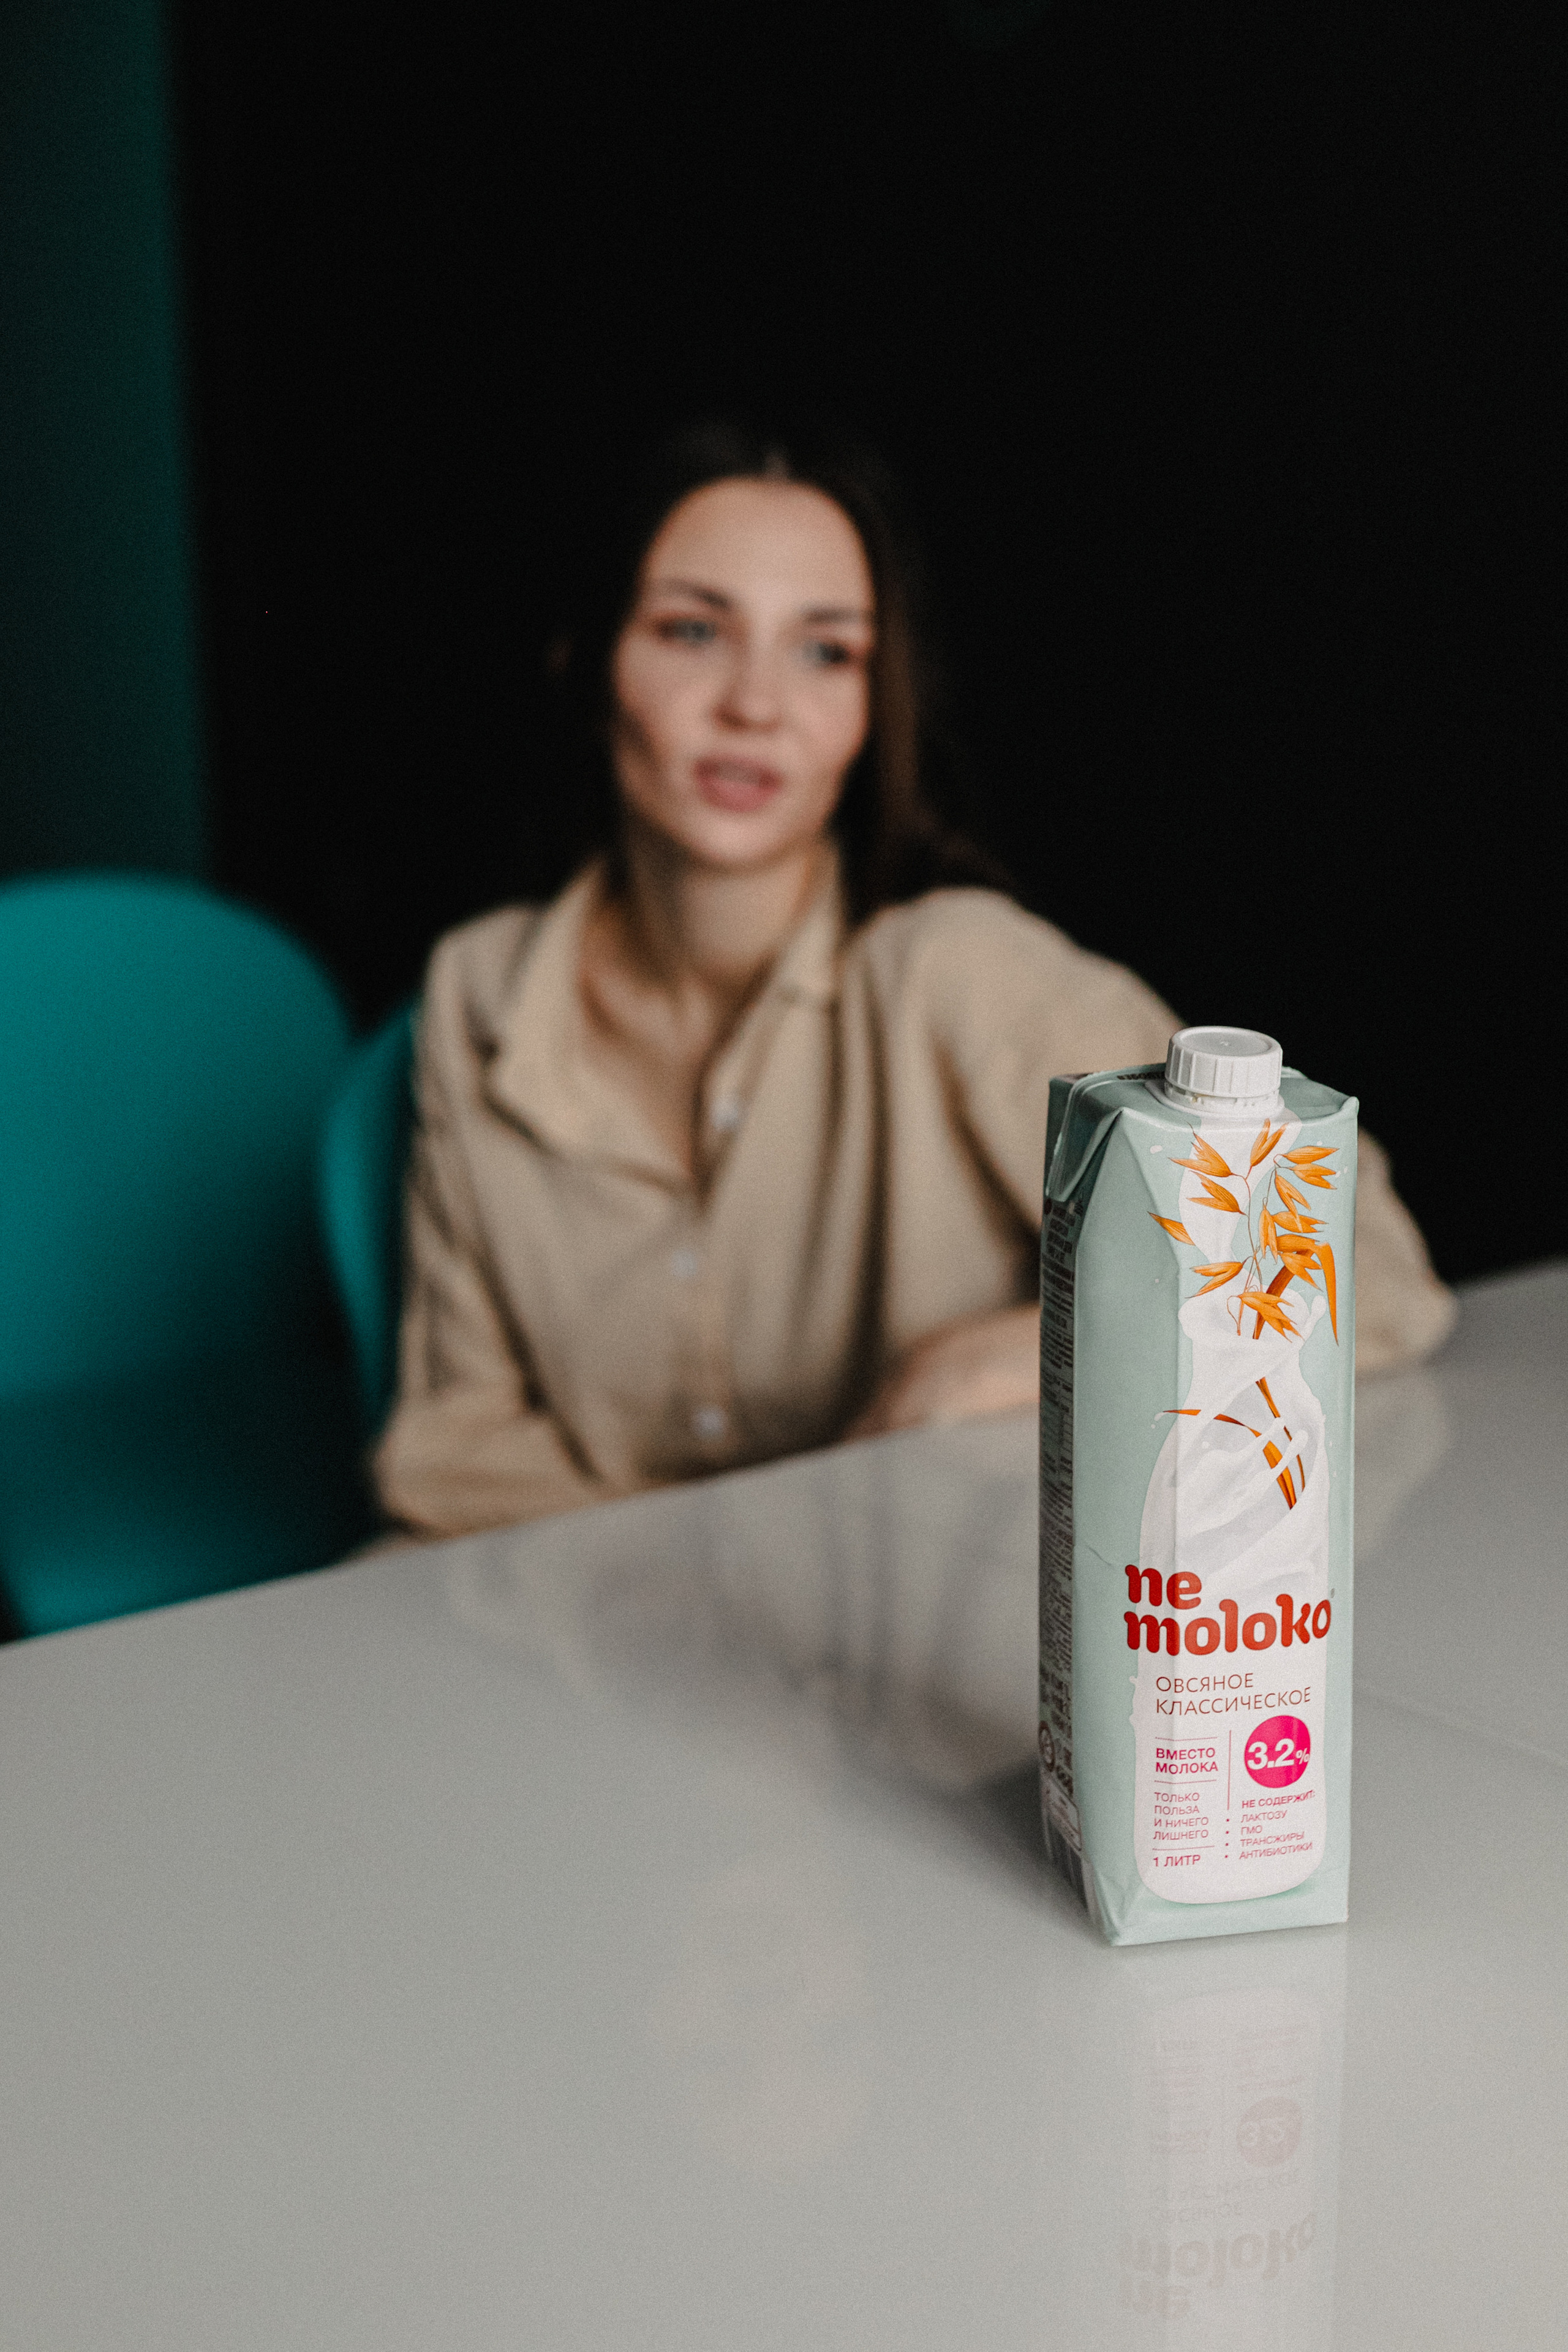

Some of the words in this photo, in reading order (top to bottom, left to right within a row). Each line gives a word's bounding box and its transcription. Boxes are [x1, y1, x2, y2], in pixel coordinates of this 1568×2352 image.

[1125, 1564, 1202, 1610] ne
[1124, 1594, 1331, 1656] moloko
[1156, 1673, 1253, 1693] ОВСЯНОЕ
[1156, 1687, 1311, 1715] КЛАССИЧЕСКОЕ
[1156, 1747, 1215, 1760] ВМЕСТО
[1248, 1738, 1310, 1770] 3.2%
[1155, 1762, 1218, 1774] МОЛОКА
[1154, 1792, 1200, 1802] ТОЛЬКО
[1154, 1805, 1200, 1815] ПОЛЬЗА
[1242, 1800, 1256, 1808] НЕ
[1154, 1818, 1162, 1826] И
[1165, 1817, 1209, 1828] НИЧЕГО
[1241, 1810, 1287, 1823] ЛАКТОЗУ
[1153, 1830, 1208, 1840] ЛИШНЕГО
[1241, 1825, 1262, 1835] ГМО
[1240, 1831, 1305, 1847] ТРАНСЖИРЫ
[1239, 1842, 1313, 1860] АНТИБИОТИКИ
[1153, 1856, 1159, 1866] 1
[1164, 1854, 1200, 1867] ЛИТР
